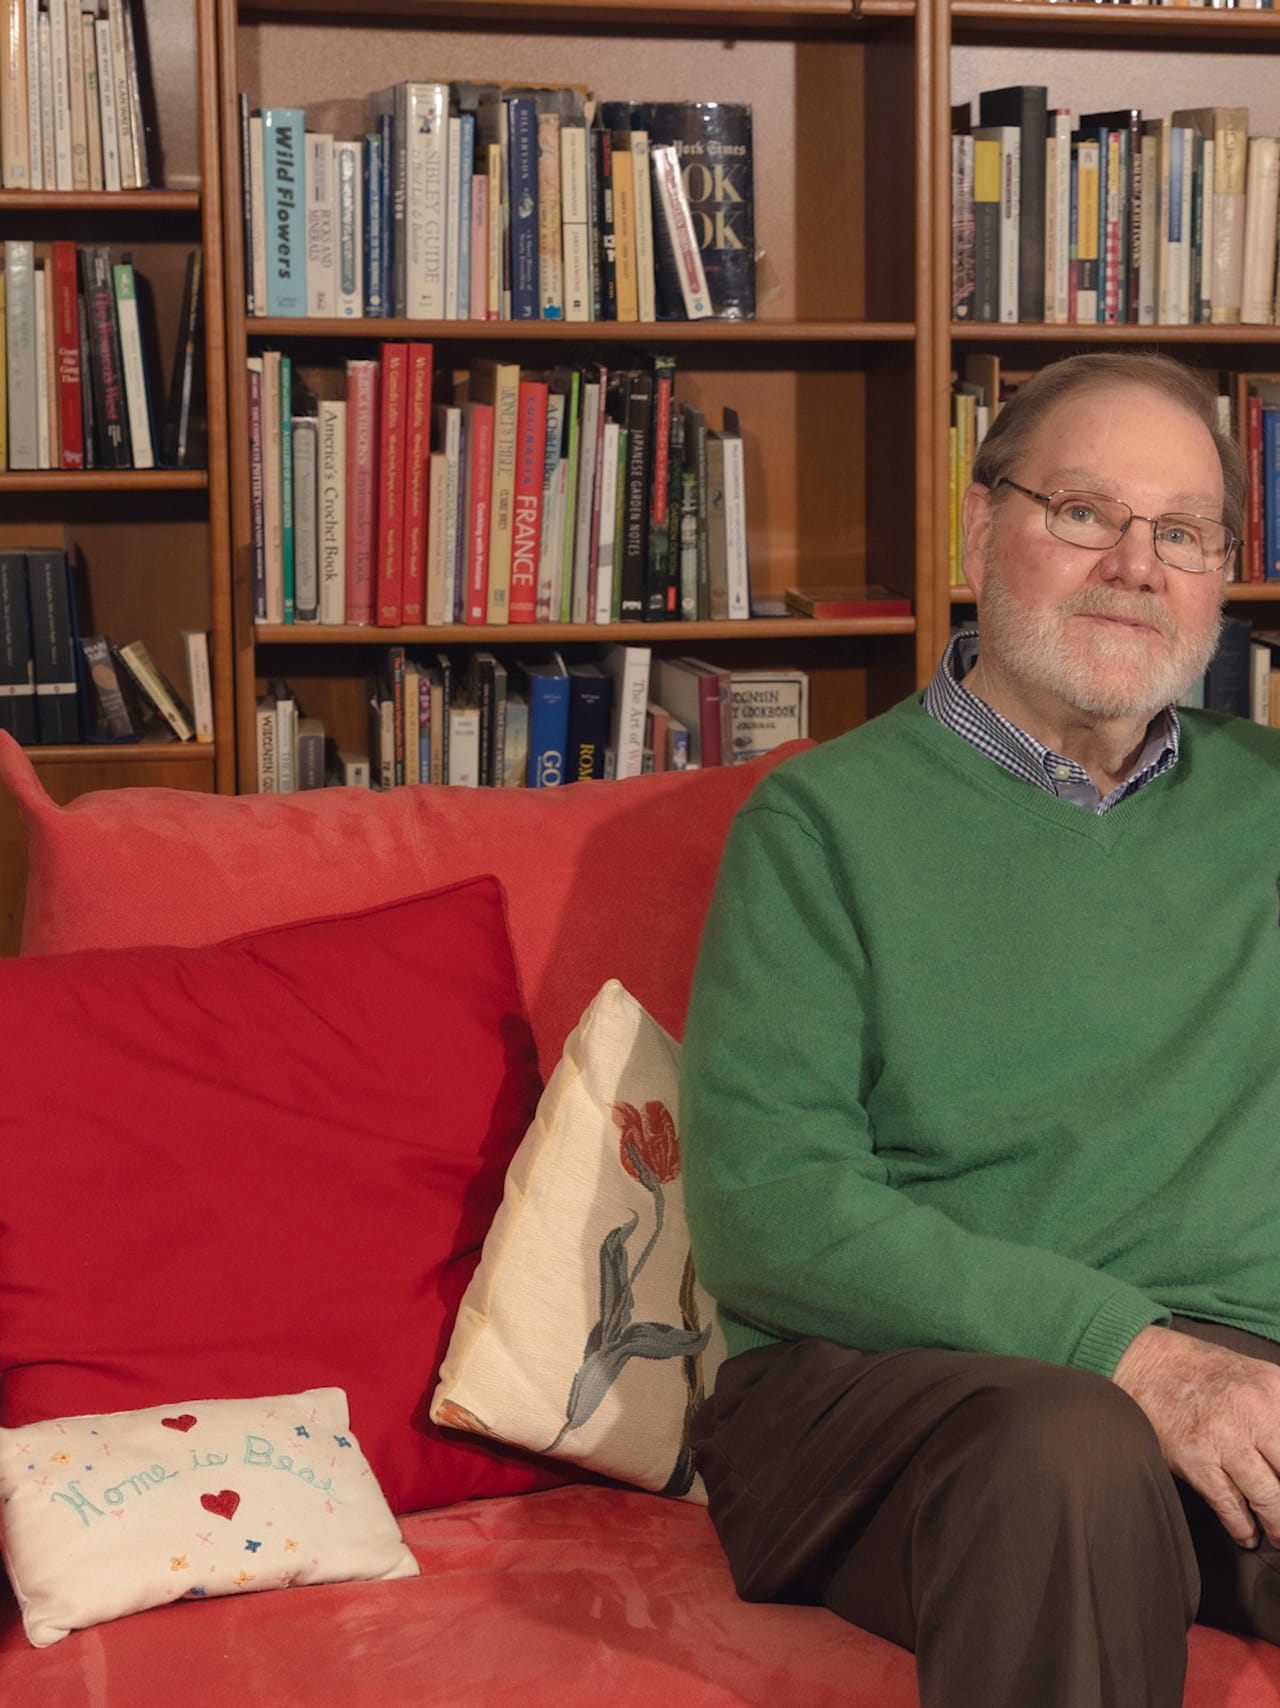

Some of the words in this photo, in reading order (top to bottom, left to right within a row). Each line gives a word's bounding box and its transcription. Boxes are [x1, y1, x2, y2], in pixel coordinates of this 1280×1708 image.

[520, 109, 529, 133] BILL
[275, 126, 294, 182] Wild
[520, 136, 529, 179] BRYSON
[425, 150, 441, 214] SIBLEY
[276, 187, 296, 280] Flowers
[309, 209, 320, 261] MINERALS
[321, 209, 332, 245] ROCKS
[322, 246, 331, 268] AND
[424, 220, 441, 284] GUIDE
[96, 291, 110, 317] The
[105, 386, 118, 420] West
[547, 404, 558, 414] A
[324, 409, 338, 481] America's
[523, 396, 536, 486] CULINARIA
[545, 416, 559, 447] Child
[544, 450, 557, 460] Is
[630, 428, 644, 477] JAPANESE
[542, 463, 557, 491] Born
[324, 487, 338, 542] Crochet
[474, 502, 486, 536] Cooking
[629, 480, 642, 521] GARDEN
[670, 502, 679, 540] GARDEN
[475, 537, 485, 554] with
[512, 495, 538, 586] FRANCE
[628, 524, 641, 557] NOTES
[325, 546, 339, 583] Book
[357, 551, 370, 585] Book
[631, 680, 646, 705] The
[630, 706, 644, 730] Art
[262, 714, 273, 773] WISCONSIN
[629, 733, 641, 747] of
[52, 1464, 178, 1528] Home
[190, 1449, 229, 1470] is
